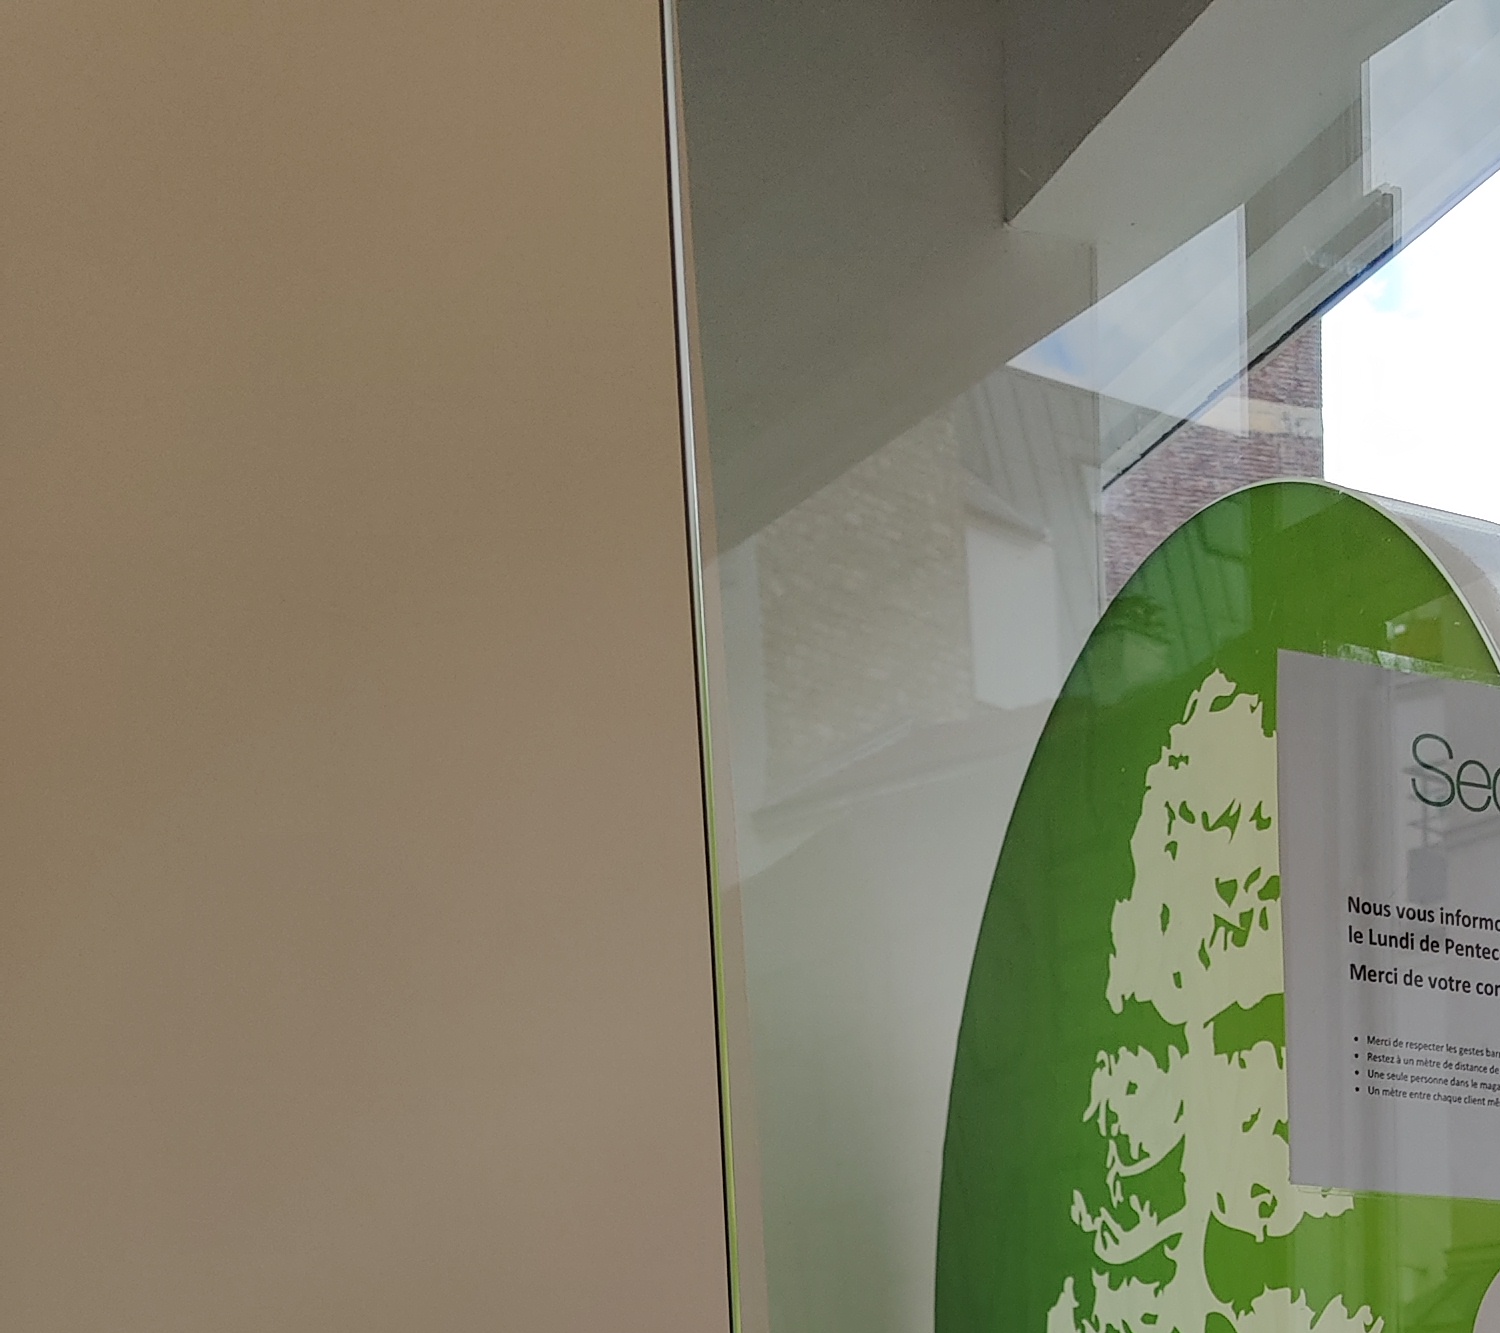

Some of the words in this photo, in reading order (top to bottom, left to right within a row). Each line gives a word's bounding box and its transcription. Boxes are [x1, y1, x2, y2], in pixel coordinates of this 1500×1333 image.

[1347, 895, 1392, 918] Nous
[1396, 905, 1435, 923] vous
[1348, 924, 1363, 944] le
[1368, 927, 1415, 950] Lundi
[1419, 934, 1440, 953] de
[1349, 963, 1398, 985] Merci
[1403, 968, 1424, 988] de
[1428, 975, 1471, 994] votre
[1366, 1035, 1391, 1047] Merci
[1392, 1037, 1403, 1048] de
[1405, 1040, 1444, 1053] respecter
[1446, 1043, 1457, 1054] les
[1458, 1046, 1484, 1057] gestes
[1366, 1052, 1394, 1064] Restez
[1396, 1054, 1402, 1065] à
[1403, 1056, 1414, 1065] un
[1415, 1057, 1441, 1069] mètre
[1442, 1060, 1453, 1070] de
[1454, 1061, 1487, 1074] distance
[1489, 1064, 1500, 1075] de
[1367, 1069, 1385, 1080] Une
[1386, 1071, 1408, 1082] seule
[1410, 1074, 1448, 1086] personne
[1450, 1077, 1469, 1088] dans
[1471, 1079, 1478, 1089] le
[1367, 1085, 1380, 1096] Un
[1381, 1087, 1407, 1099] mètre
[1409, 1090, 1431, 1101] entre
[1433, 1092, 1462, 1105] chaque
[1463, 1094, 1485, 1106] client
